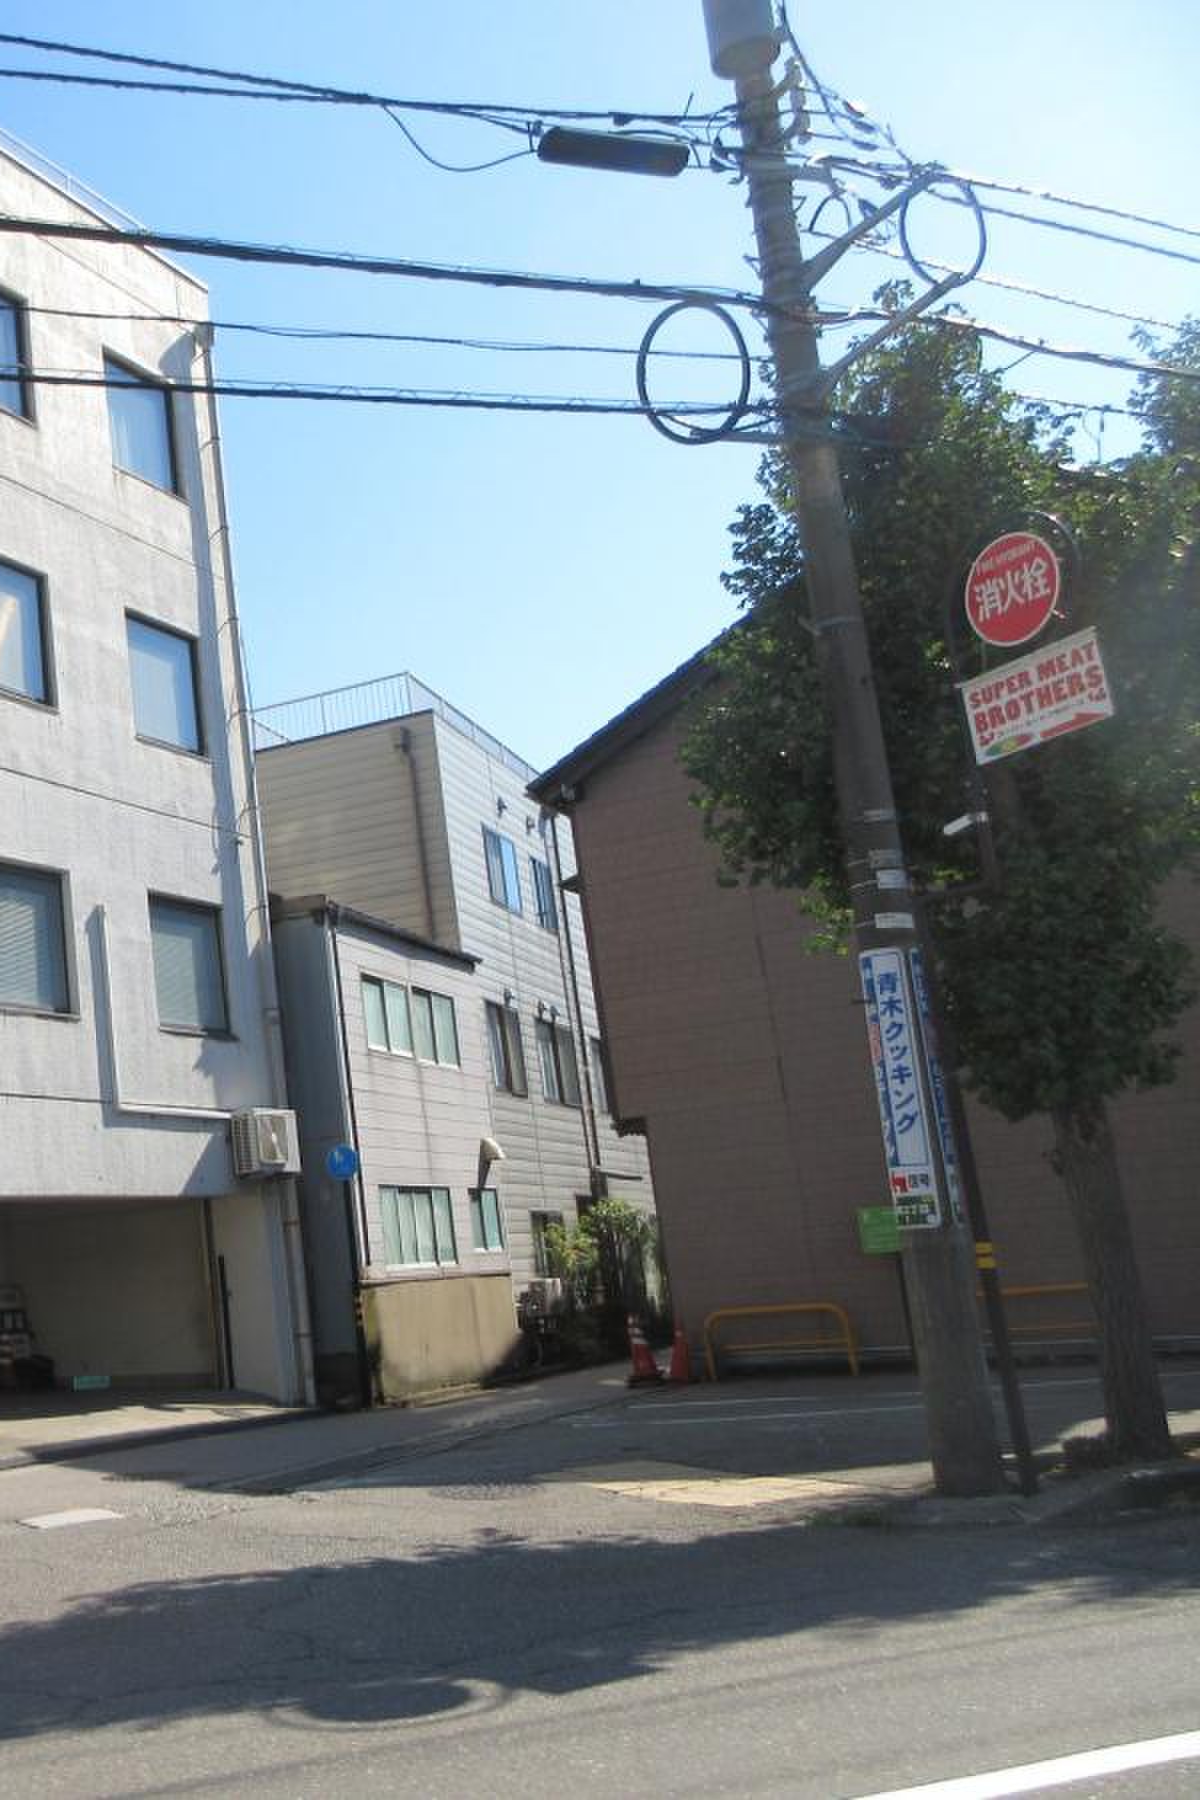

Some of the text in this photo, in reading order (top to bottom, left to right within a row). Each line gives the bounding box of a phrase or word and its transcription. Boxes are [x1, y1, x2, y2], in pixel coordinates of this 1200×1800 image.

[975, 557, 1050, 622] 消火栓
[969, 641, 1096, 709] SUPER MEAT
[974, 665, 1104, 734] BROTHERS
